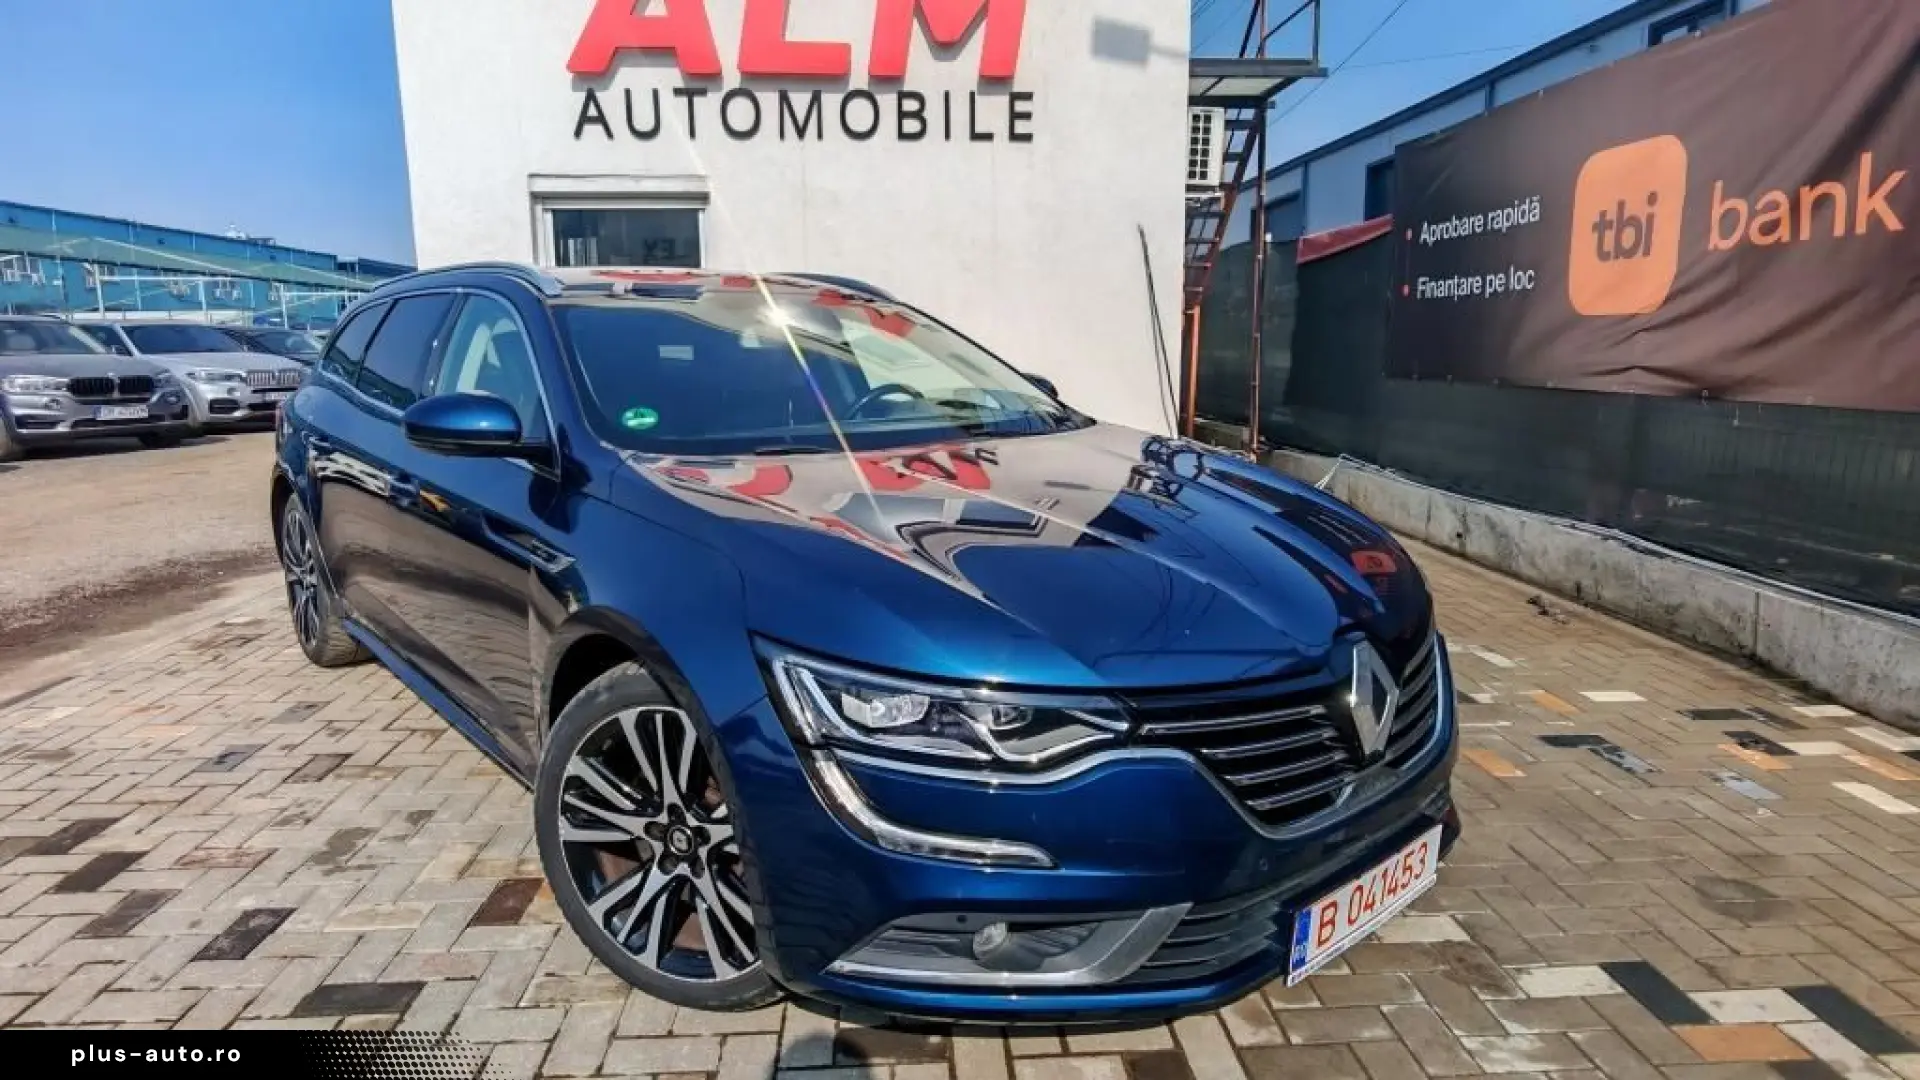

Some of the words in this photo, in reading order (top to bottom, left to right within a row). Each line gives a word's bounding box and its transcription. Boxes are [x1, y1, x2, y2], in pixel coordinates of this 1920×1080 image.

[566, 0, 1026, 77] ALM
[573, 87, 1034, 142] AUTOMOBILE
[1419, 214, 1484, 246] Aprobare
[1487, 195, 1541, 233] rapidă
[1591, 191, 1658, 262] tbi
[1708, 151, 1908, 251] bank
[1484, 272, 1506, 299] pe
[1509, 264, 1535, 290] loc
[1317, 900, 1339, 948] B
[1347, 841, 1429, 927] 041453
